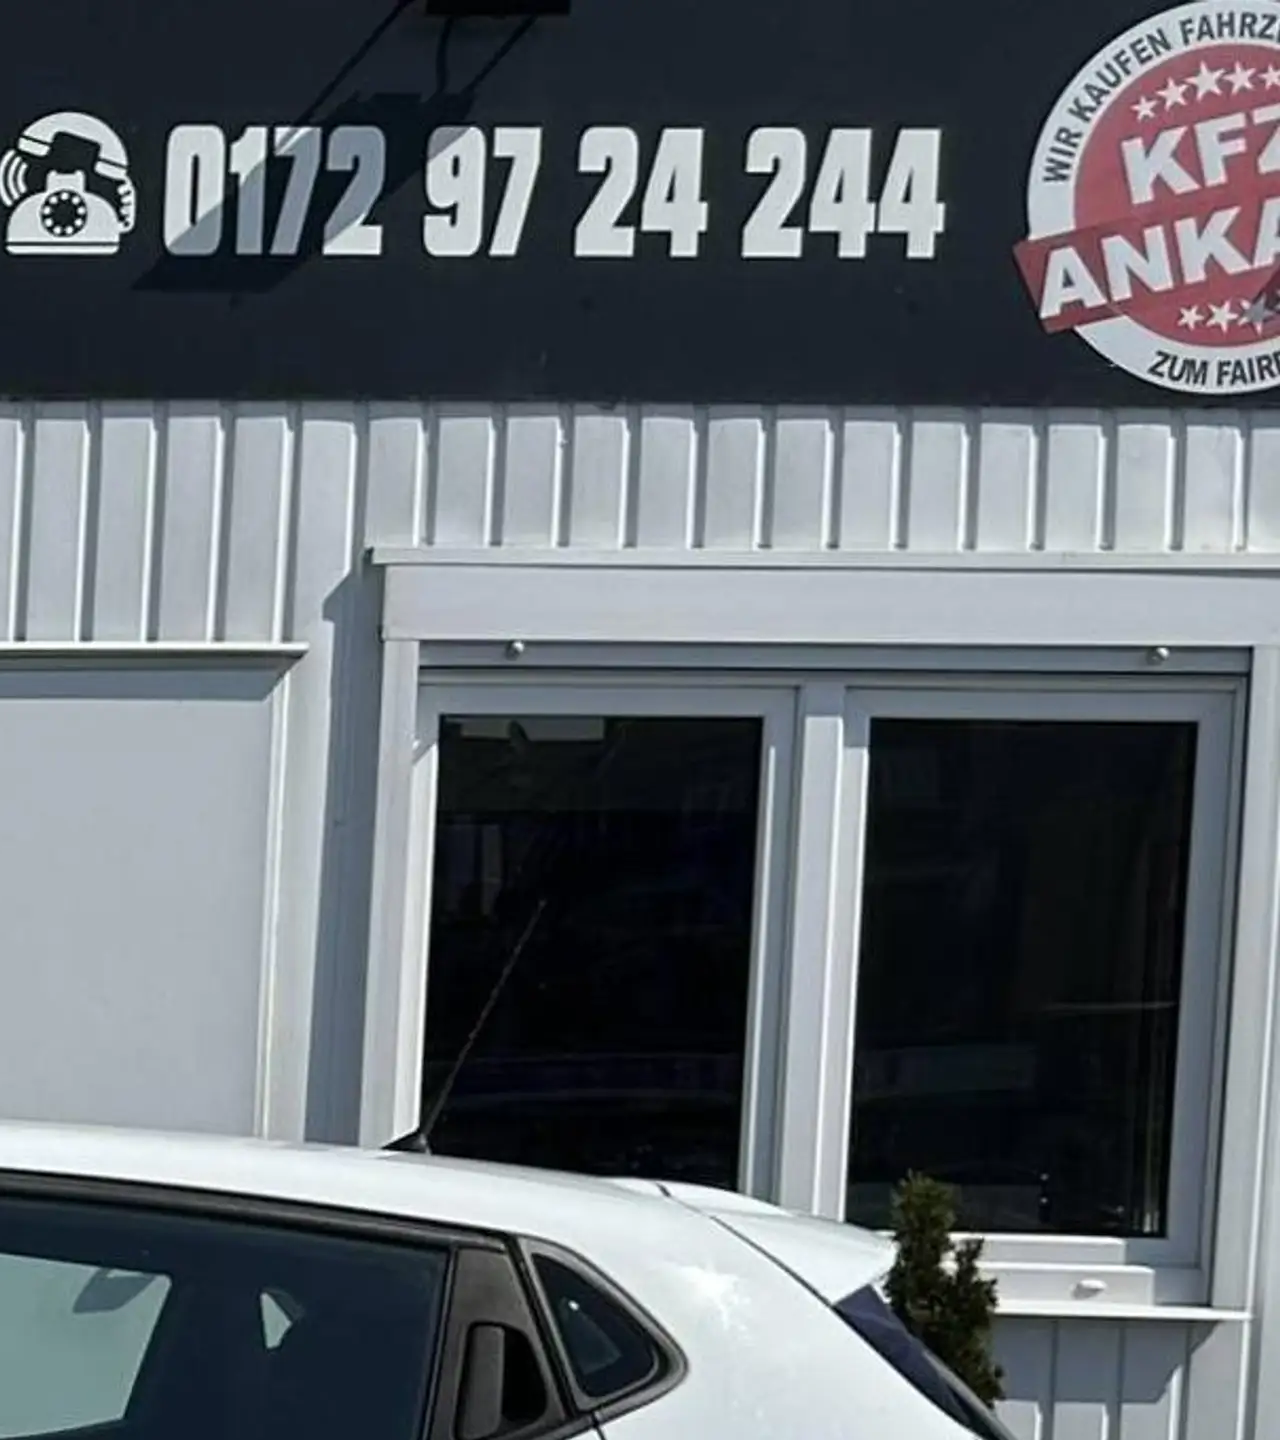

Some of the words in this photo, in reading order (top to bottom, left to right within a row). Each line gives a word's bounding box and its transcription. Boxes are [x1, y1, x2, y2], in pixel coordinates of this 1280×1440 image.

[1042, 125, 1084, 184] WIR
[1067, 27, 1172, 123] KAUFEN
[1179, 10, 1280, 46] FAHRZ
[163, 124, 386, 256] 0172
[423, 125, 543, 257] 97
[573, 126, 709, 258] 24
[740, 126, 947, 260] 244
[1147, 350, 1208, 386] ZUM
[1216, 351, 1280, 386] FAIR
